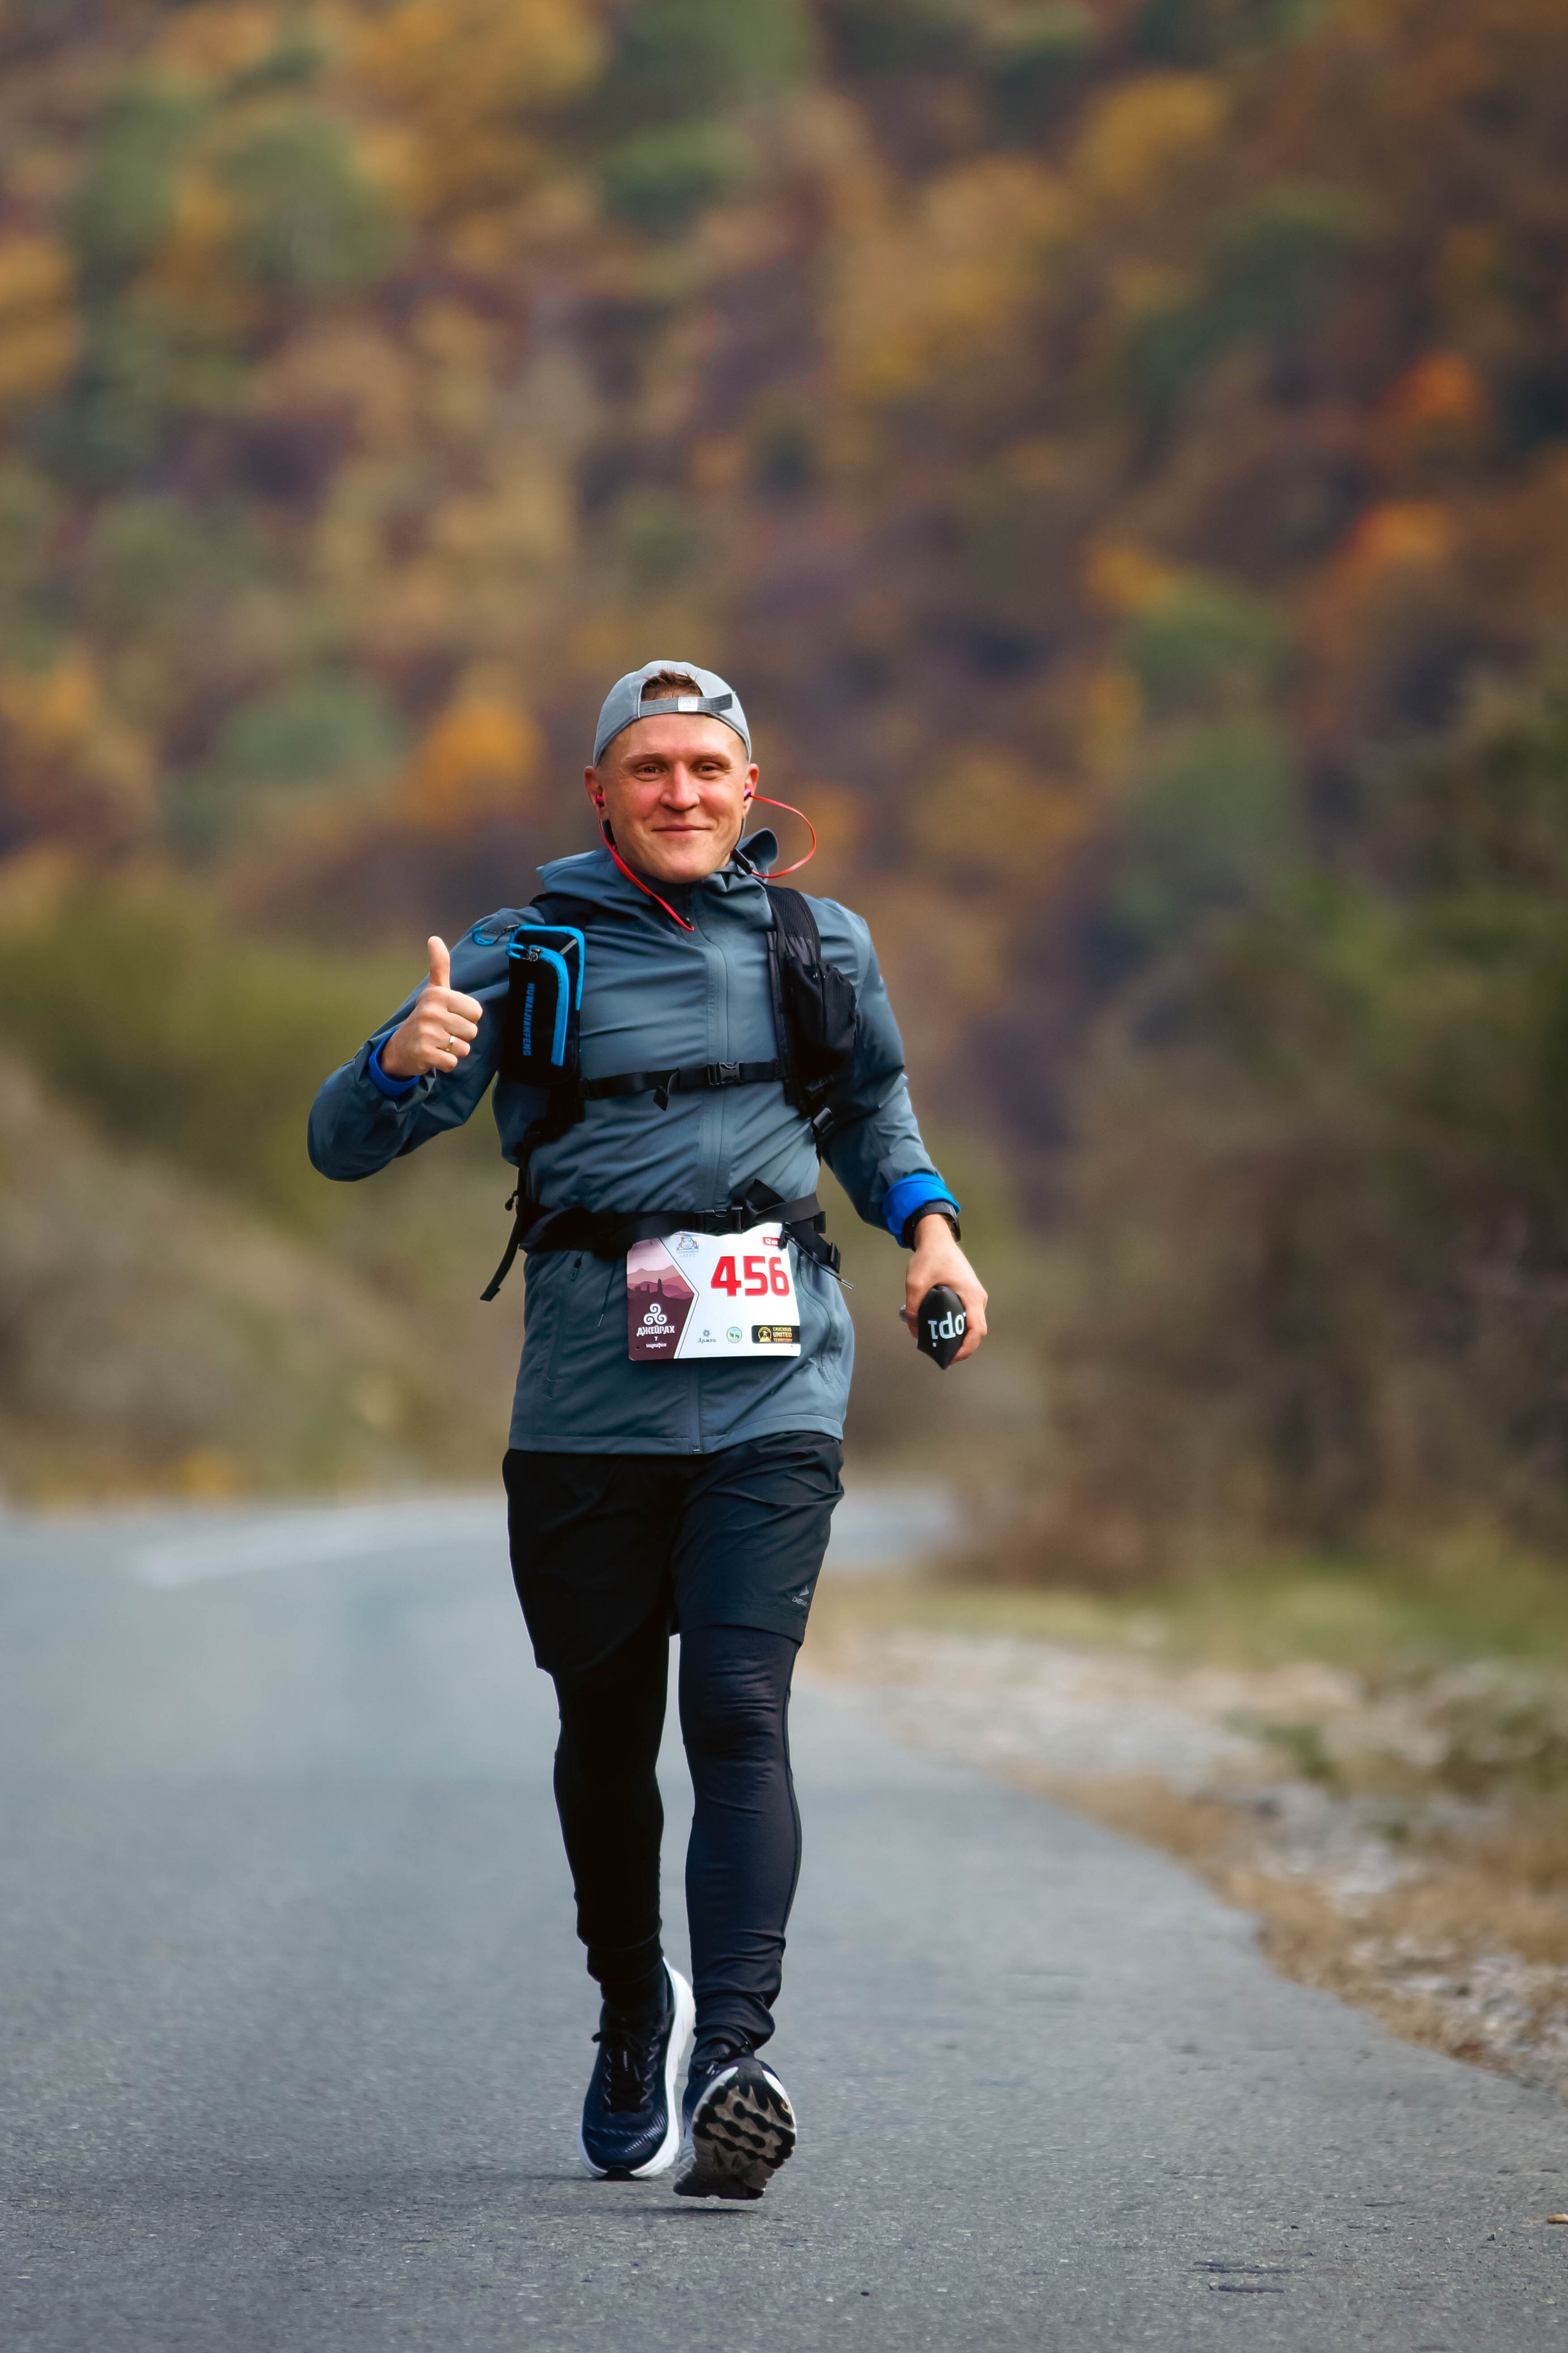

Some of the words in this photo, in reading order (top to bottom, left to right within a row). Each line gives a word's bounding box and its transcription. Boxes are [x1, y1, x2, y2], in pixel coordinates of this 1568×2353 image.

[522, 983, 535, 1056] HUWAIJIANFENG
[710, 1256, 790, 1297] 456
[636, 1325, 675, 1337] ДЖЕЙРАХ
